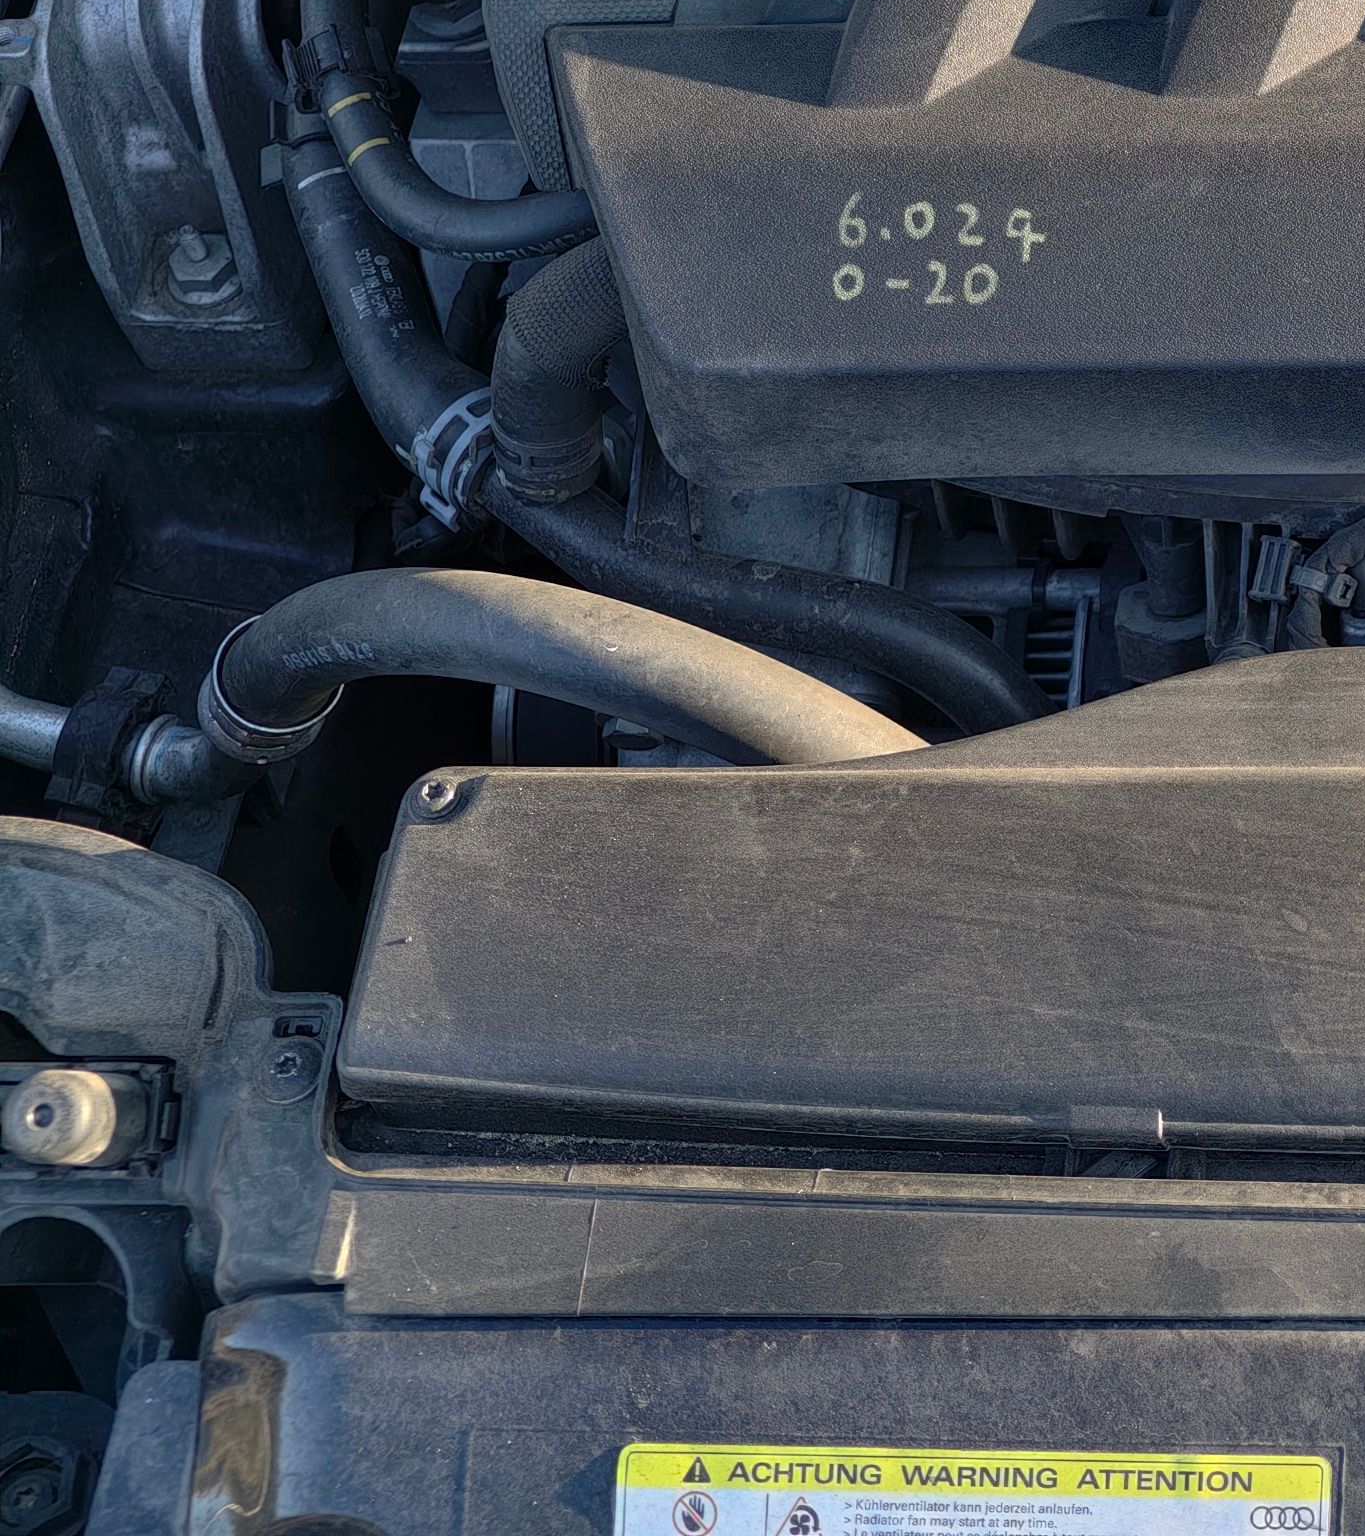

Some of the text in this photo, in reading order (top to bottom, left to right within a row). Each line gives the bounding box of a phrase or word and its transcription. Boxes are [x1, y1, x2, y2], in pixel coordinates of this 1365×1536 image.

[832, 260, 999, 305] 0-20
[728, 1462, 1253, 1493] ACHTUNG WARNING ATTENTION
[855, 1499, 1093, 1516] Kühlerventilator kann jederzeit anlaufen.
[854, 1514, 1058, 1530] Radiator fan may start at any time.
